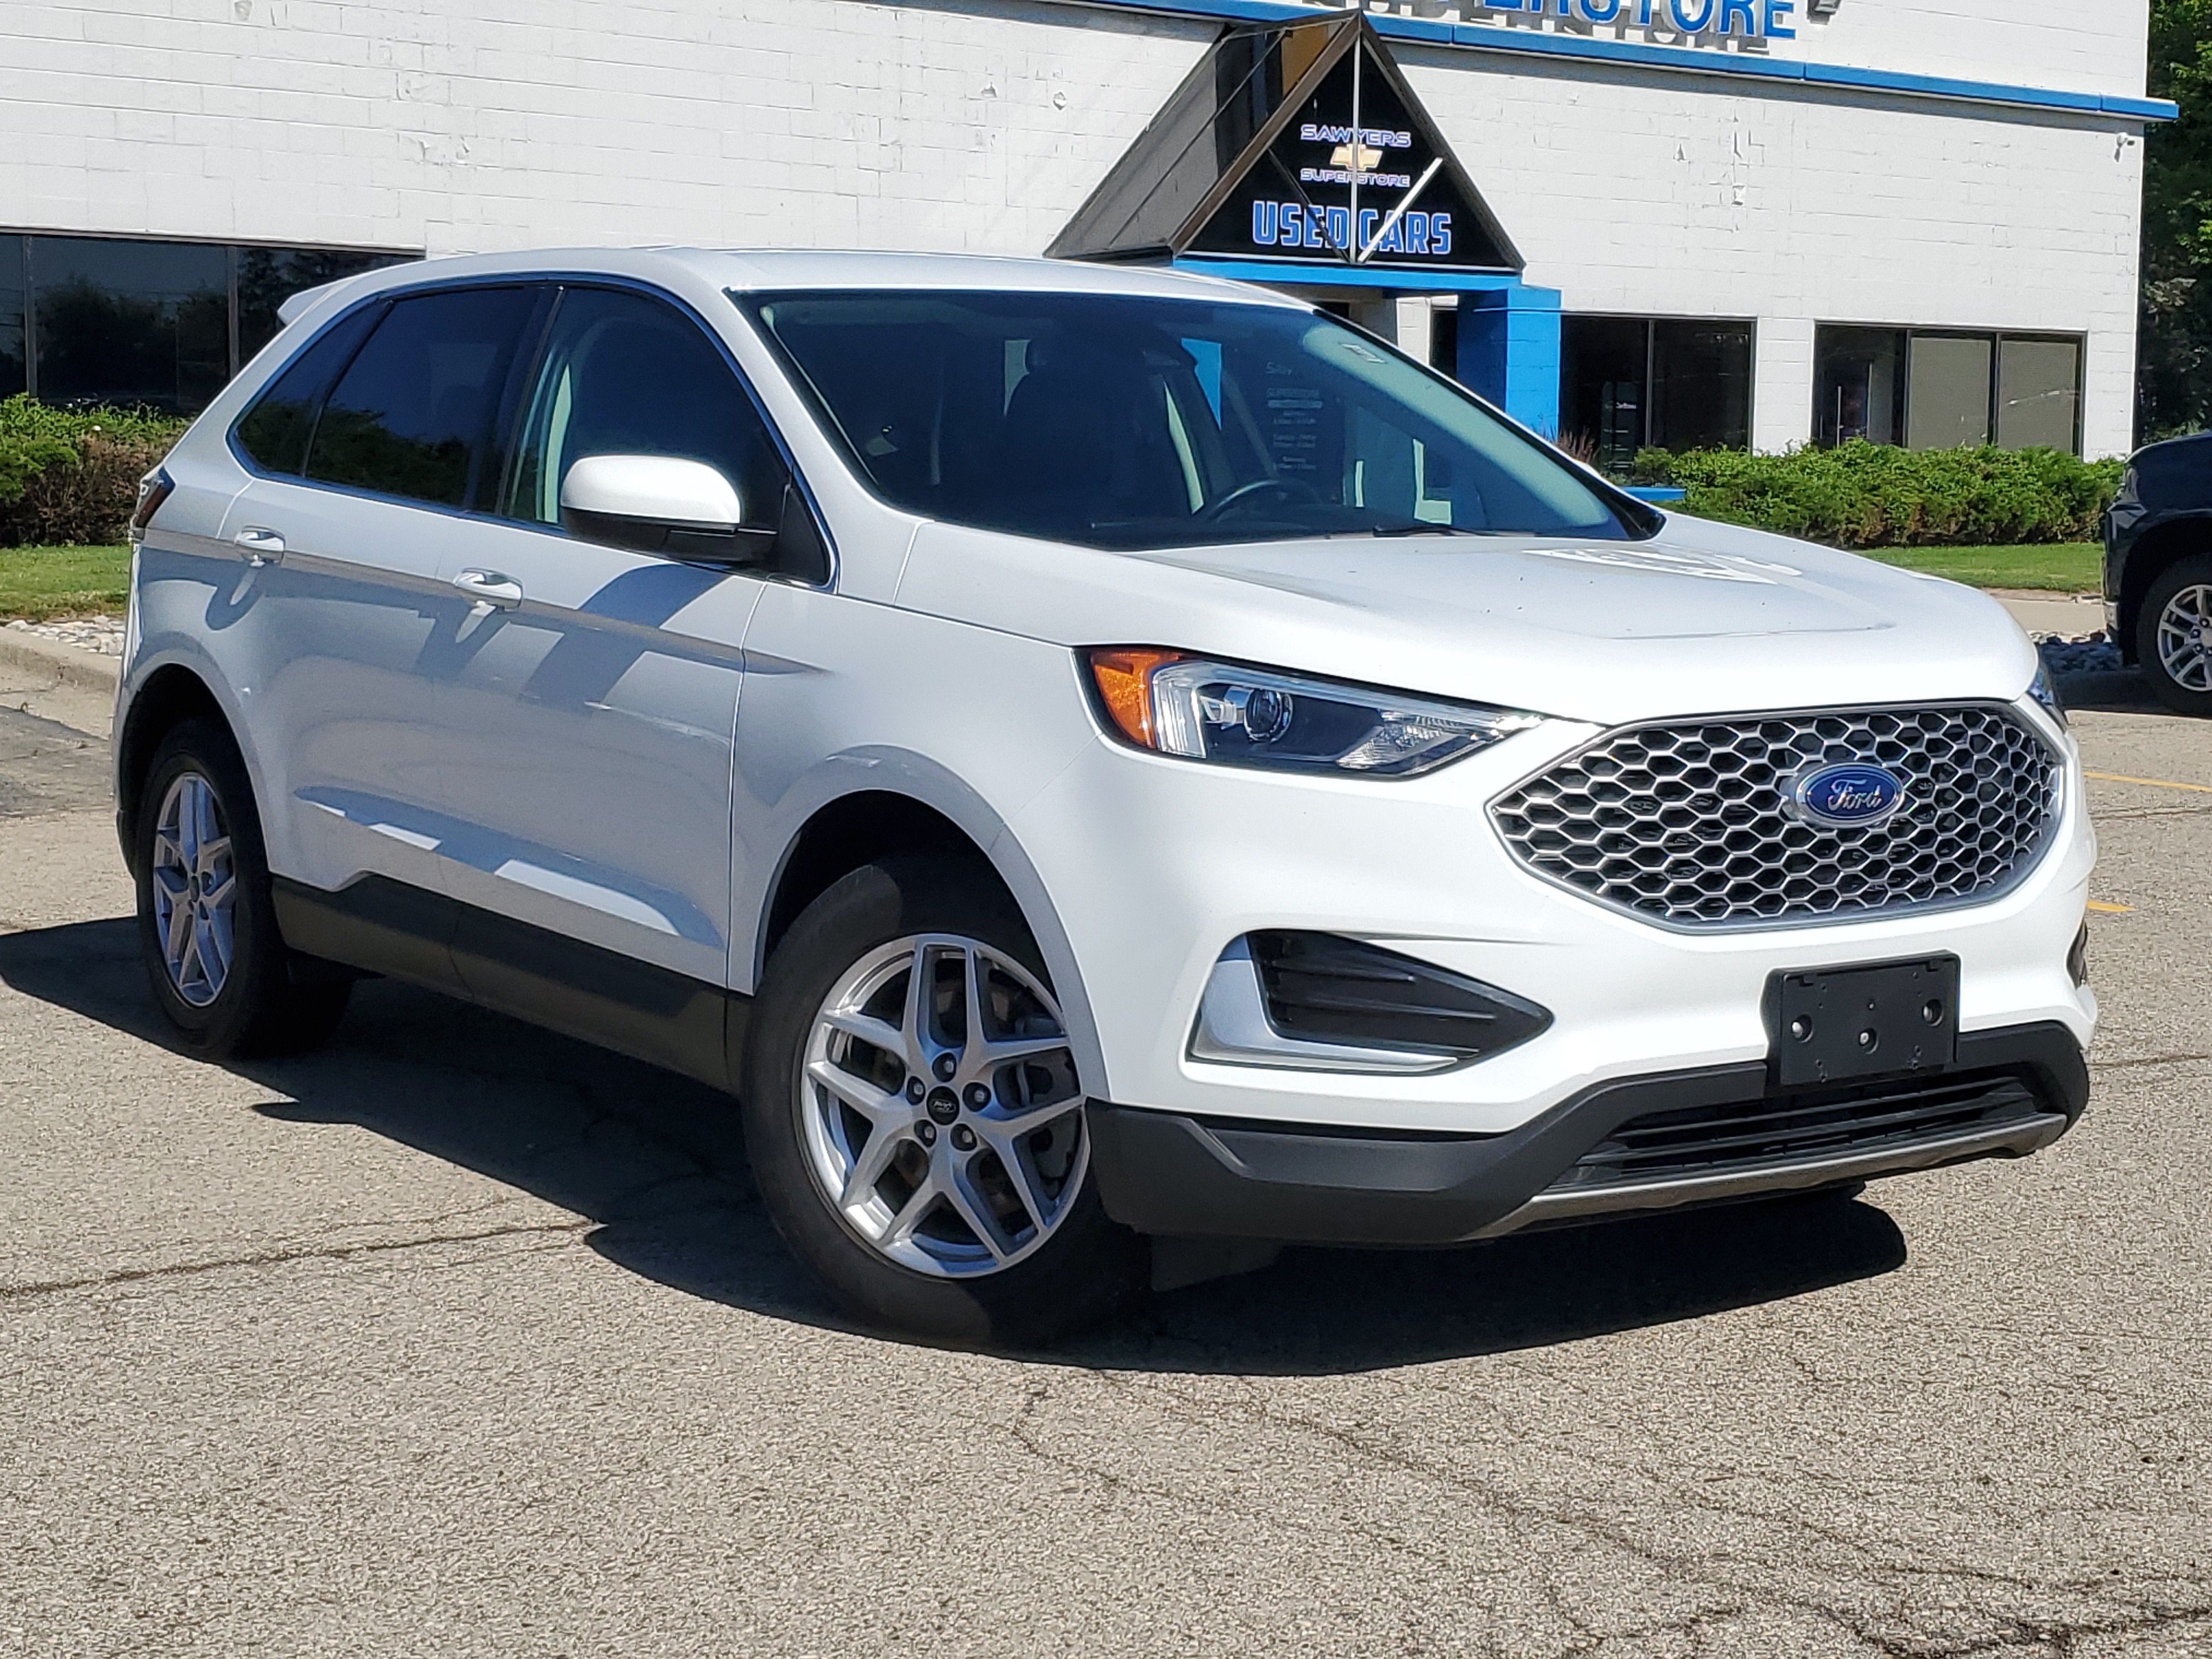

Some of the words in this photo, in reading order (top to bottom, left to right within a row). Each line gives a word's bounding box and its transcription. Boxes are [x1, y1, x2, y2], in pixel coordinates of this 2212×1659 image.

[1301, 124, 1412, 148] SAWYERS
[1301, 168, 1410, 188] SUPERSTORE
[1252, 200, 1350, 250] USED
[1359, 208, 1452, 255] CARS
[1828, 779, 1882, 811] Ford
